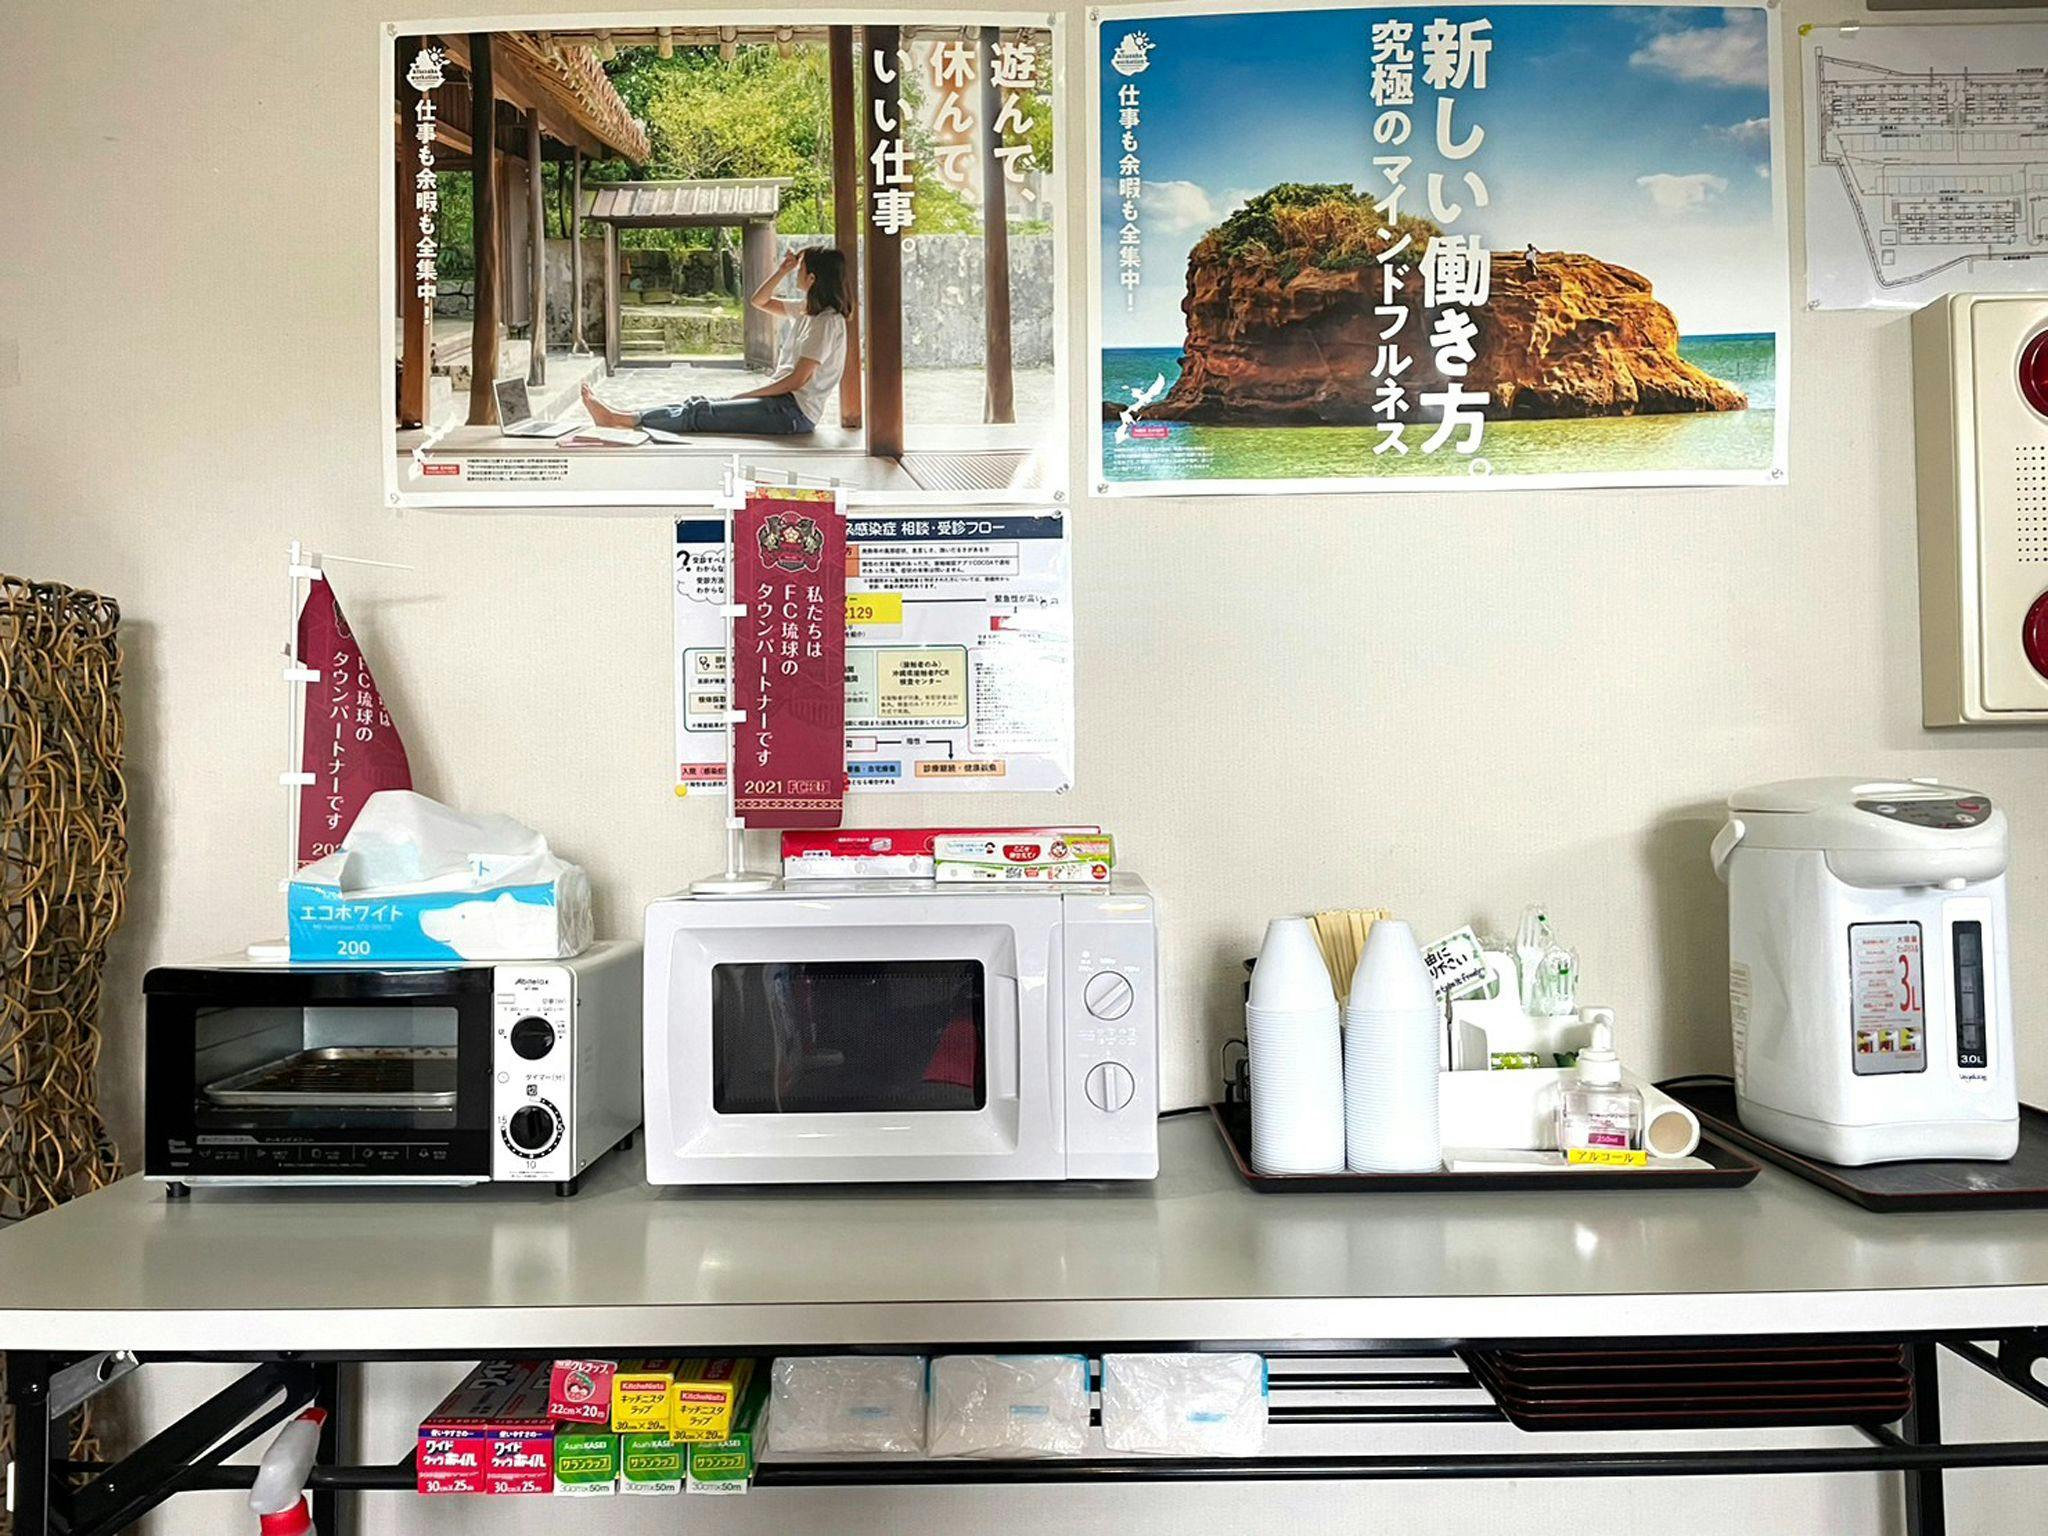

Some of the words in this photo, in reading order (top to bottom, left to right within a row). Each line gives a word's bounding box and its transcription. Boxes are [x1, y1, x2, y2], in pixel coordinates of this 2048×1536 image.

[930, 41, 976, 201] 休んで、
[990, 42, 1036, 202] 遊んで、
[870, 49, 917, 253] いい仕事。
[1371, 18, 1414, 457] 究極のマインドフルネス
[1420, 17, 1494, 477] 新しい働き方。
[901, 520, 1006, 537] 相談・受診フロー
[806, 585, 824, 658] 私たちは
[781, 583, 800, 677] FC琉球の
[755, 582, 775, 767] タウンパートナーです
[326, 650, 350, 831] タウンパートナーです
[744, 779, 783, 795] 2021
[300, 904, 403, 922] エコホワイト
[337, 940, 371, 956] 200
[526, 1160, 537, 1170] 10
[1577, 1151, 1634, 1163] アルコール
[620, 1394, 664, 1404] キッチニスタ
[631, 1405, 653, 1414] ラップ
[680, 1405, 725, 1415] キッチニスタ
[689, 1417, 713, 1426] ラップ
[425, 1440, 455, 1454] ワイド
[494, 1441, 523, 1456] ワイド
[562, 1459, 609, 1471] サランラップ
[630, 1457, 675, 1468] サランラップ
[697, 1456, 743, 1468] サランラップ
